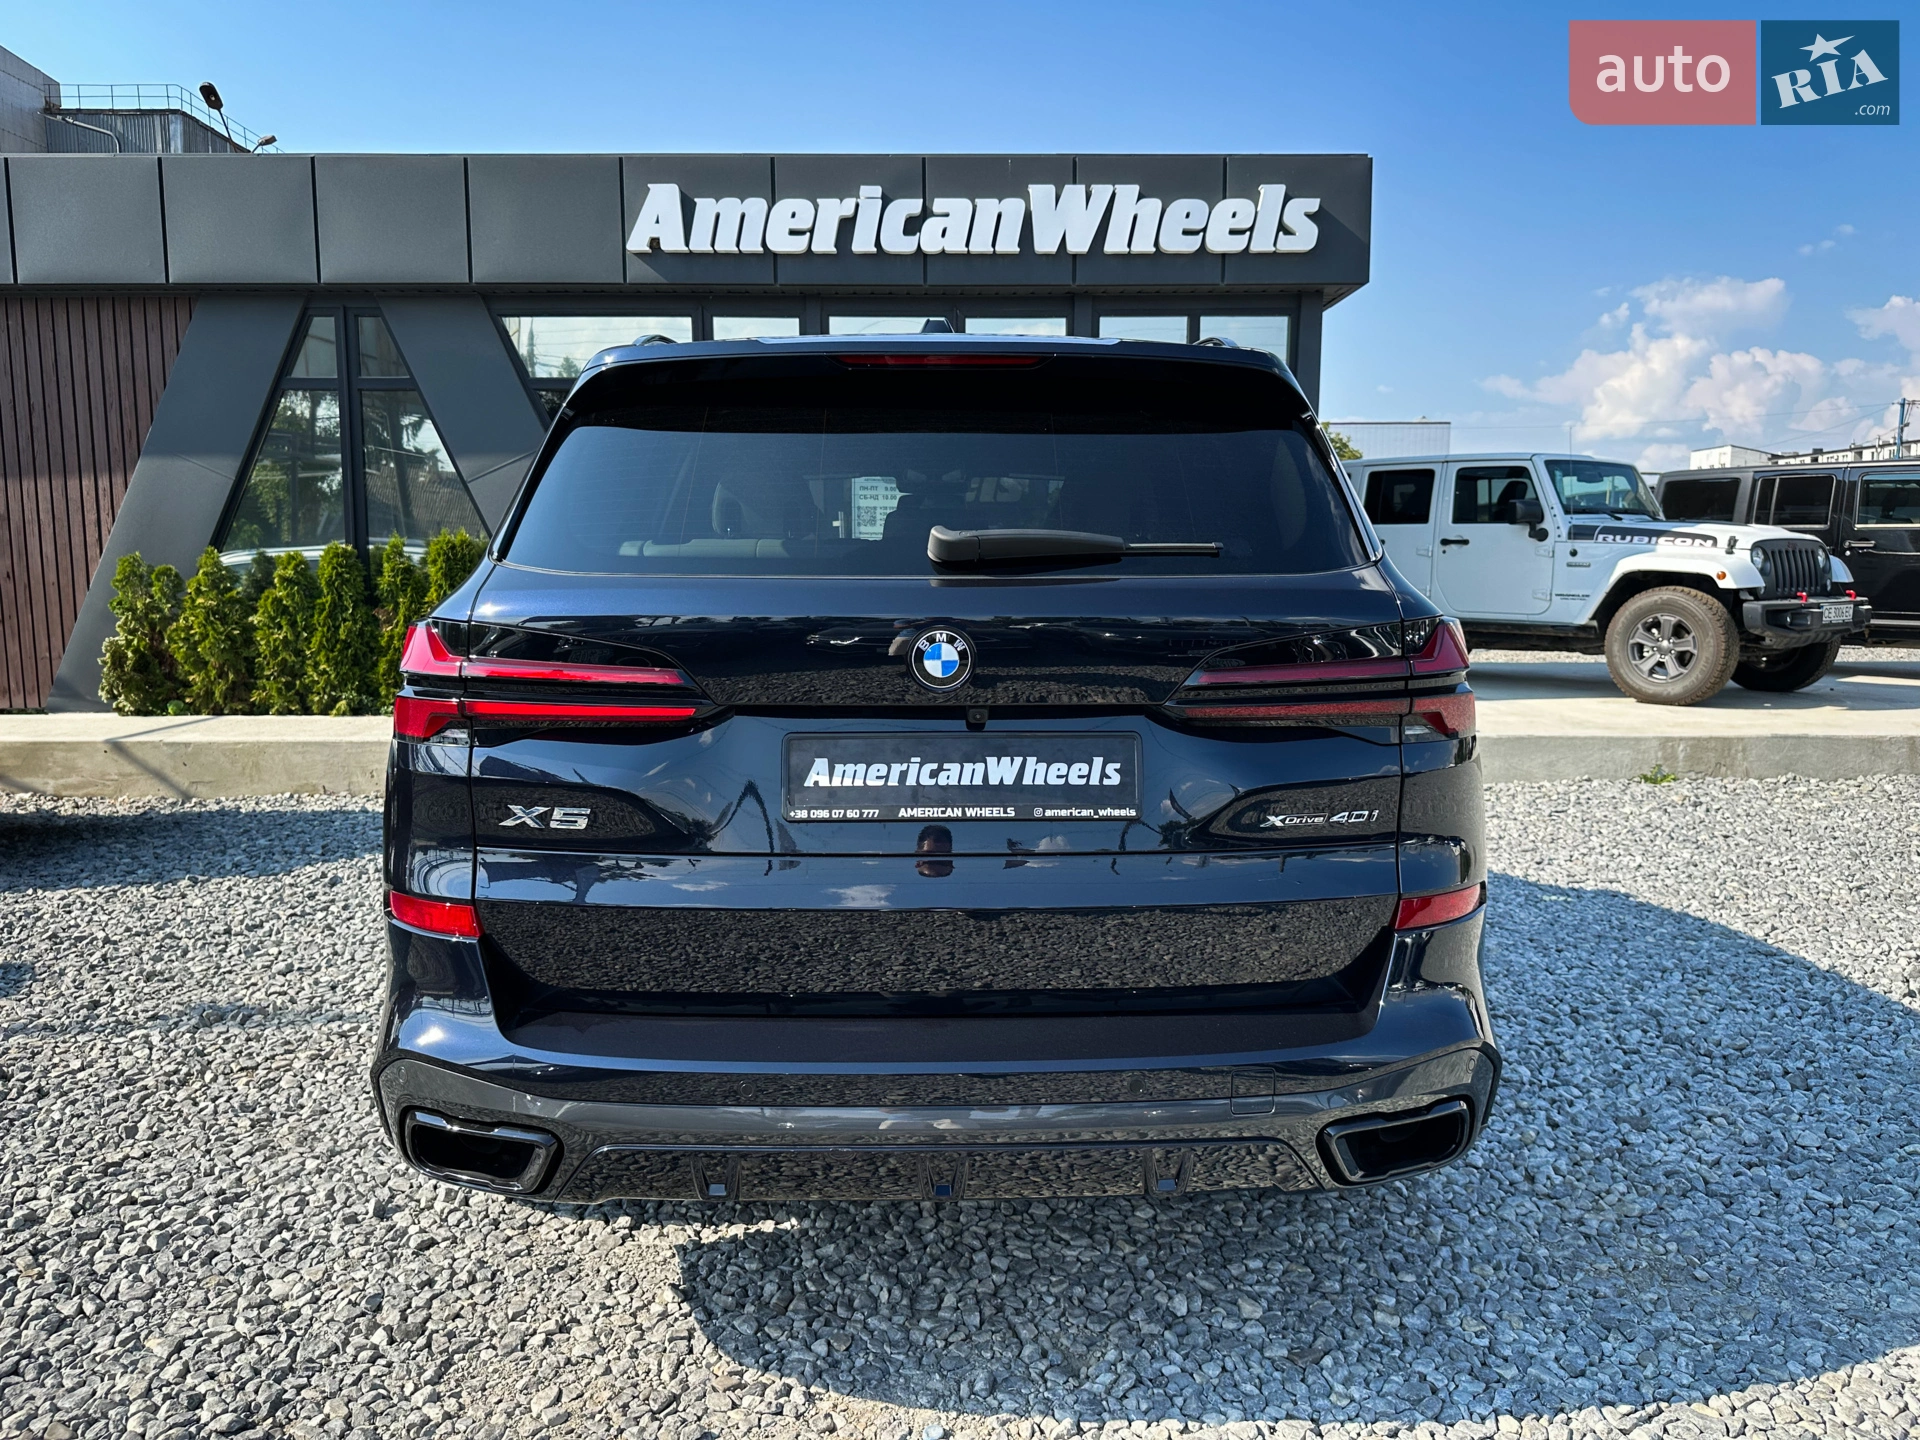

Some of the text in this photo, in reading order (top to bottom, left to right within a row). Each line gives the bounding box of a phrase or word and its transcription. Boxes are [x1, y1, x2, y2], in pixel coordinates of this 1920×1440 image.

[626, 183, 1321, 255] AmericanWheels
[1597, 534, 1714, 548] RUBICON
[918, 633, 966, 652] BMW
[803, 756, 1122, 788] AmericanWheels
[498, 804, 591, 830] X5
[789, 809, 880, 819] +38 096 07 60 777
[898, 807, 1016, 818] AMERICAN WHEELS
[1044, 807, 1137, 818] american_wheels
[1329, 809, 1380, 823] 40i
